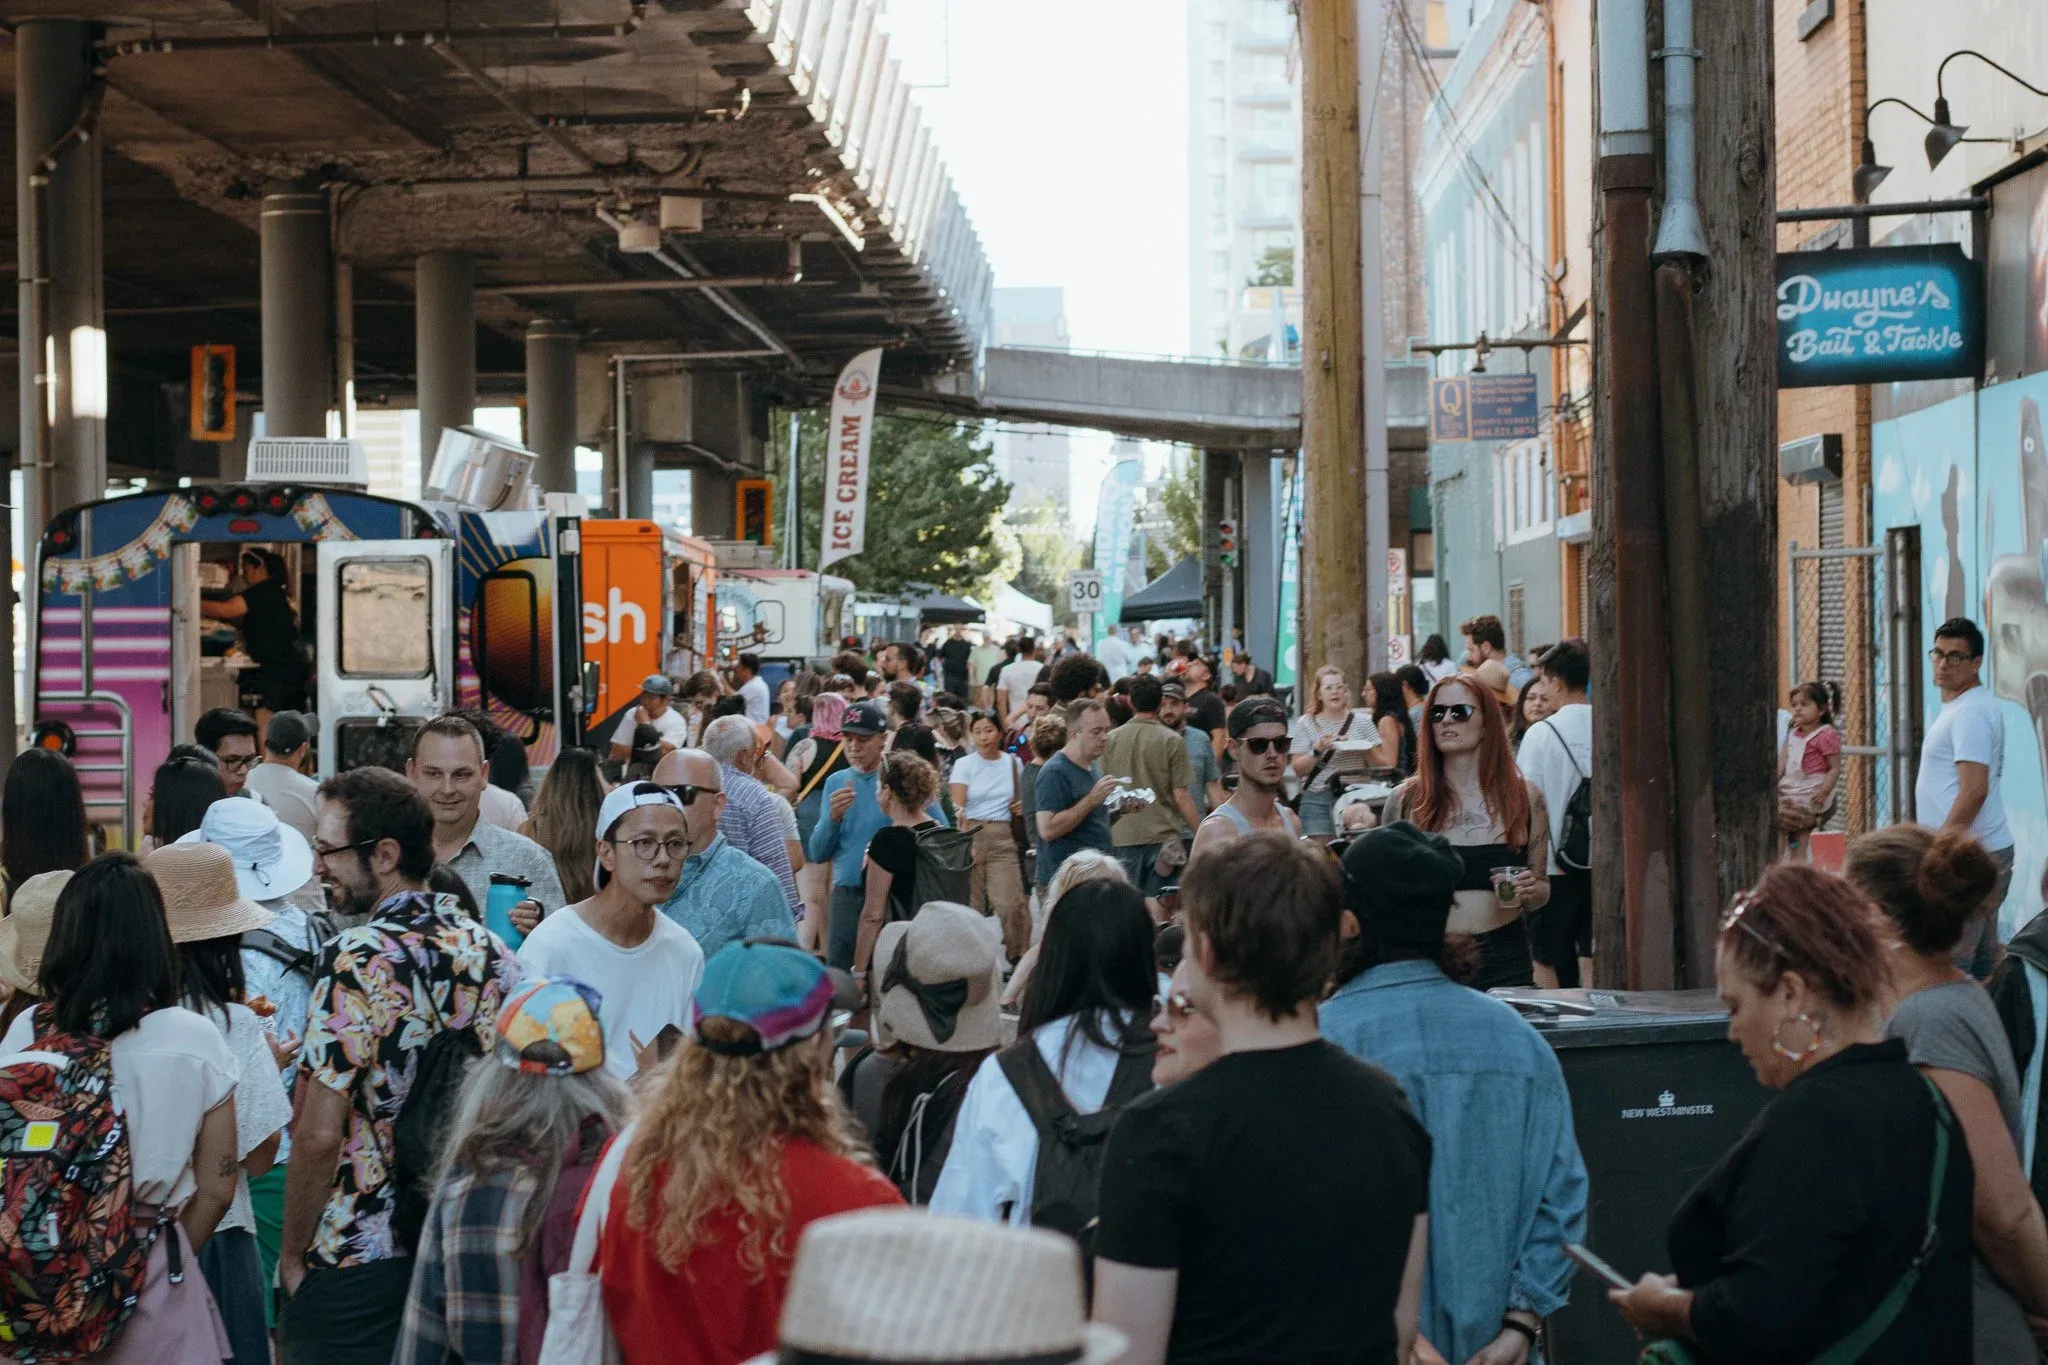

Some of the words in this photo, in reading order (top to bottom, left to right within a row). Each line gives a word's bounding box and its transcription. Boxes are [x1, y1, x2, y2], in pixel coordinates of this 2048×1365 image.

[1777, 274, 1951, 328] Dwayne's
[1786, 326, 1863, 363] Bait
[1864, 330, 1885, 355] &
[1883, 324, 1964, 352] Tackle
[1439, 382, 1462, 416] Q
[837, 415, 862, 503] CREAM
[831, 509, 854, 550] ICE
[1073, 581, 1100, 599] 30
[1621, 1108, 1645, 1119] NEW
[1646, 1104, 1714, 1118] WESTMINSTER
